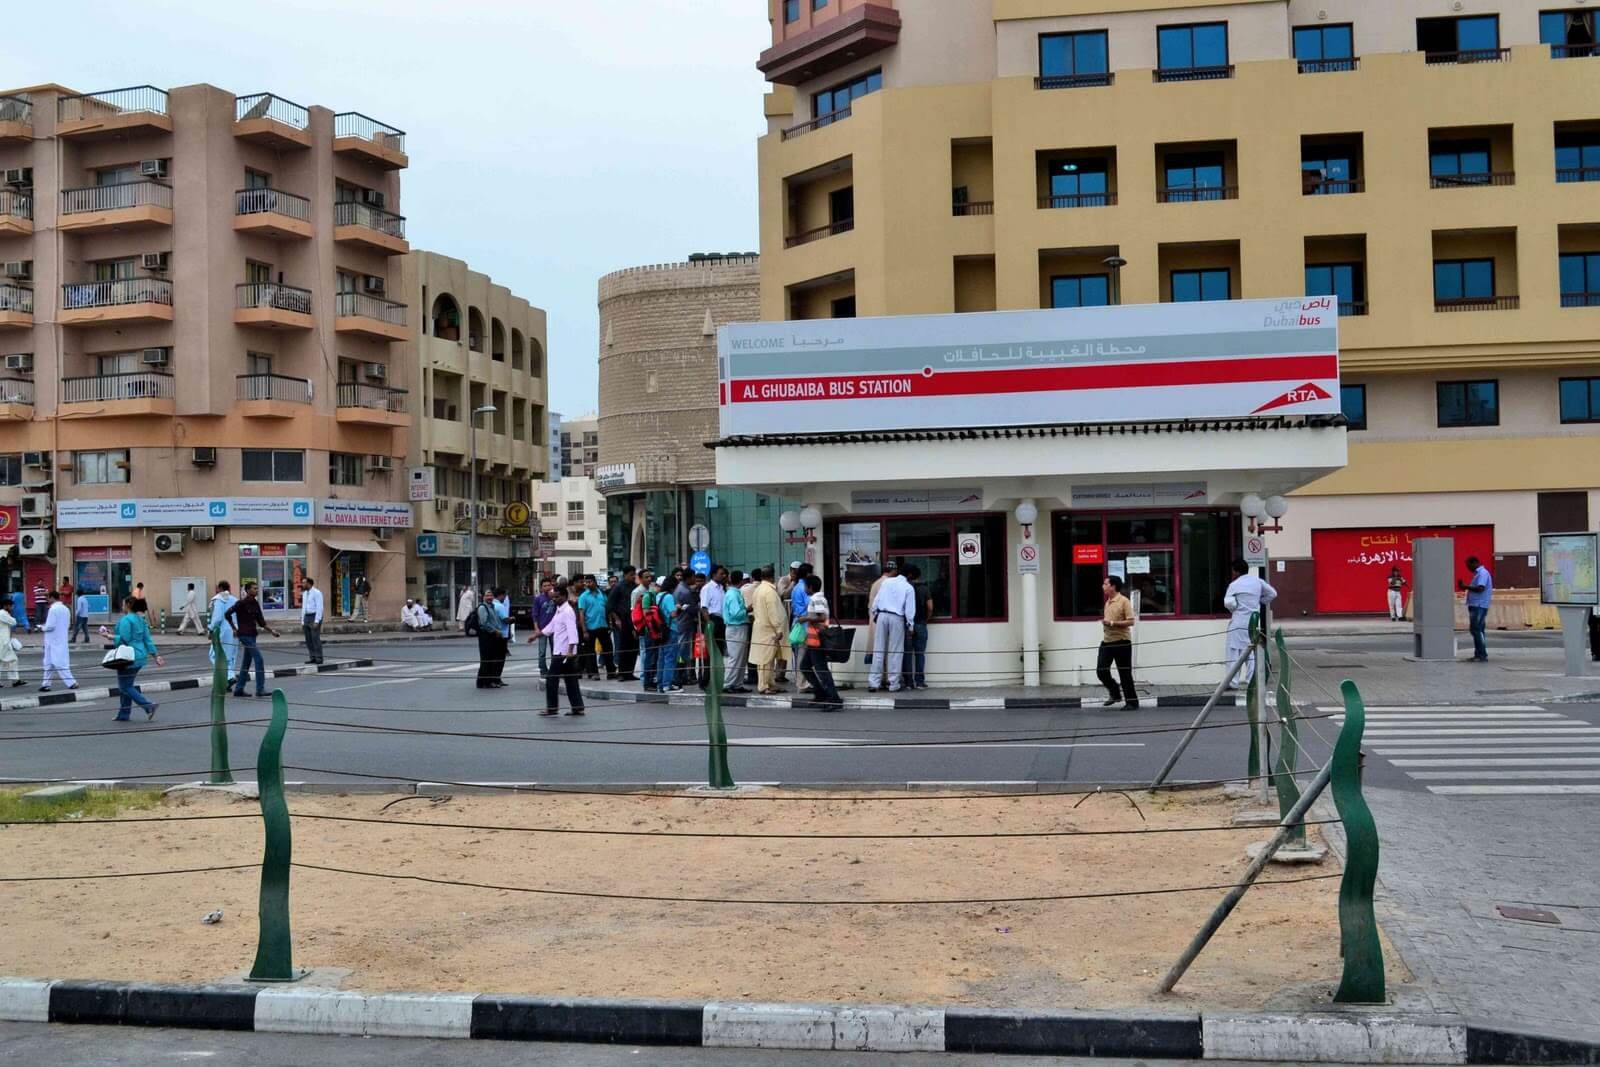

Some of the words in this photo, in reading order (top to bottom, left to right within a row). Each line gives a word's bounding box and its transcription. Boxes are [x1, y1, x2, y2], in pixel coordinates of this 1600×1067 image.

[731, 338, 784, 350] WELCOME
[1097, 343, 1146, 355] محطة
[943, 347, 1022, 363] للحافلات
[743, 385, 759, 399] AL
[761, 382, 825, 398] GHUBAIBA
[829, 381, 854, 395] BUS
[859, 379, 911, 394] STATION
[1287, 390, 1319, 402] RTA
[325, 513, 334, 523] AL
[335, 514, 359, 524] DAYAA
[359, 515, 391, 525] INTERNET
[393, 516, 409, 526] CAFE
[1360, 534, 1398, 547] افتتاح
